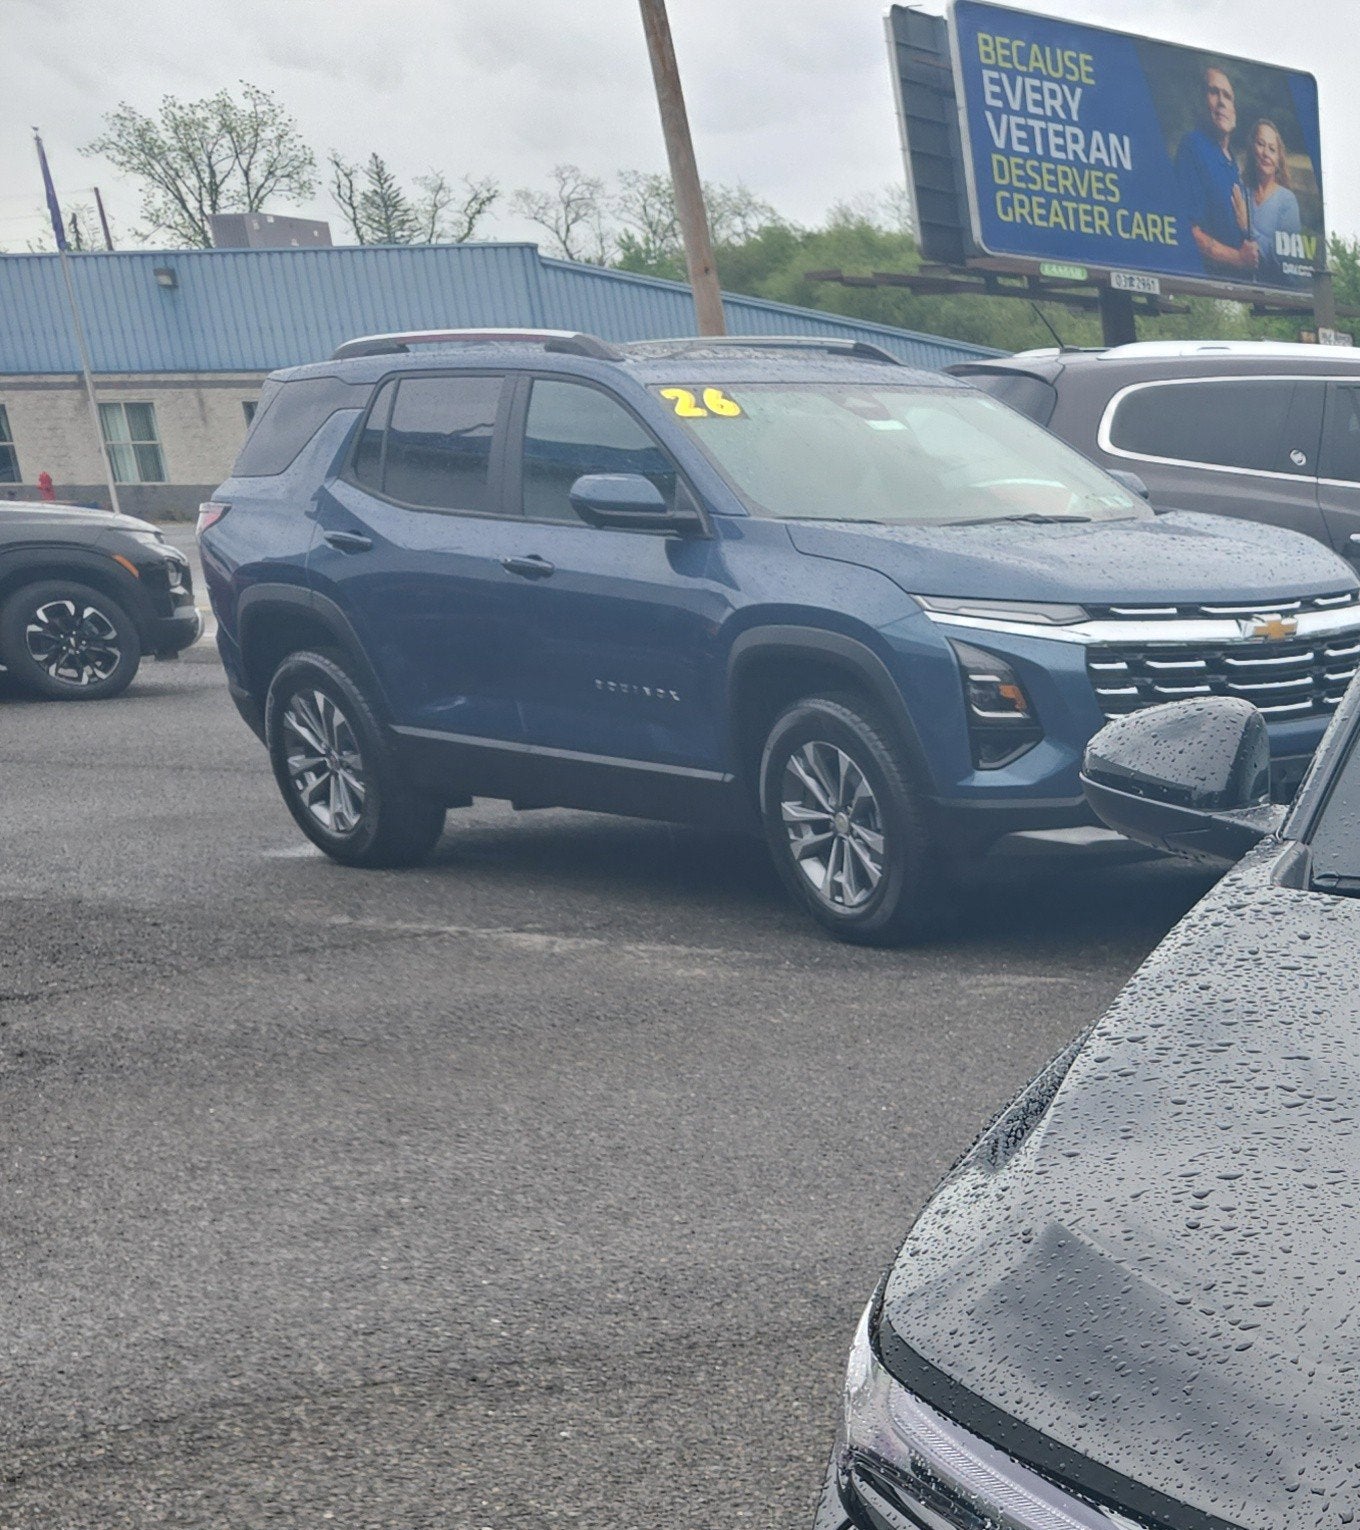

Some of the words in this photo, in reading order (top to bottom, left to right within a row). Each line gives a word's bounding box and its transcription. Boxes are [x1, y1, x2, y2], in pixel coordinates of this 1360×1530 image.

[977, 32, 1096, 85] BECAUSE
[981, 69, 1083, 122] EVERY
[984, 110, 1133, 171] VETERAN
[991, 153, 1121, 203] DESERVES
[995, 190, 1113, 237] GREATER
[1115, 208, 1179, 246] CARE
[1275, 230, 1317, 260] DAV
[660, 387, 741, 417] 26
